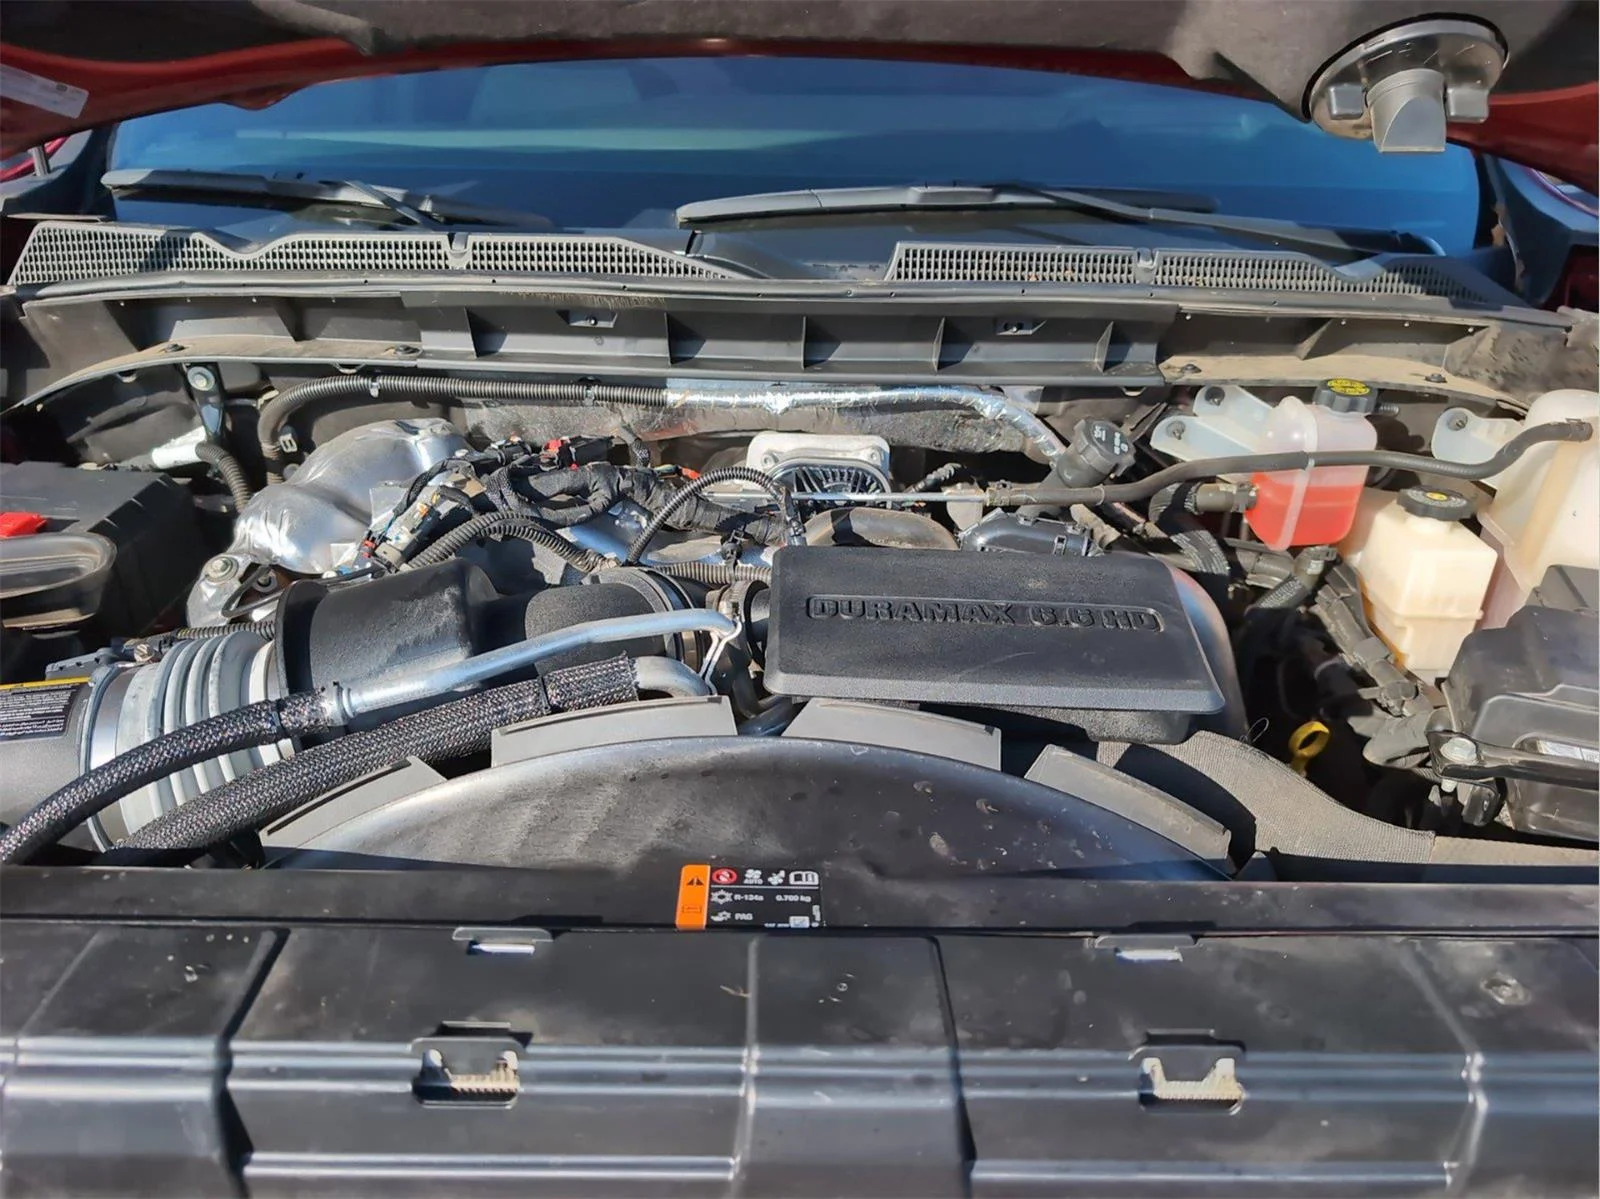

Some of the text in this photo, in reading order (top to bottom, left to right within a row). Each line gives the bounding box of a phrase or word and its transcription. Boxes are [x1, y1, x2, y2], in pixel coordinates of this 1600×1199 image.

[808, 598, 1162, 632] DURAMAX 6.6 HD
[734, 913, 753, 921] PAG
